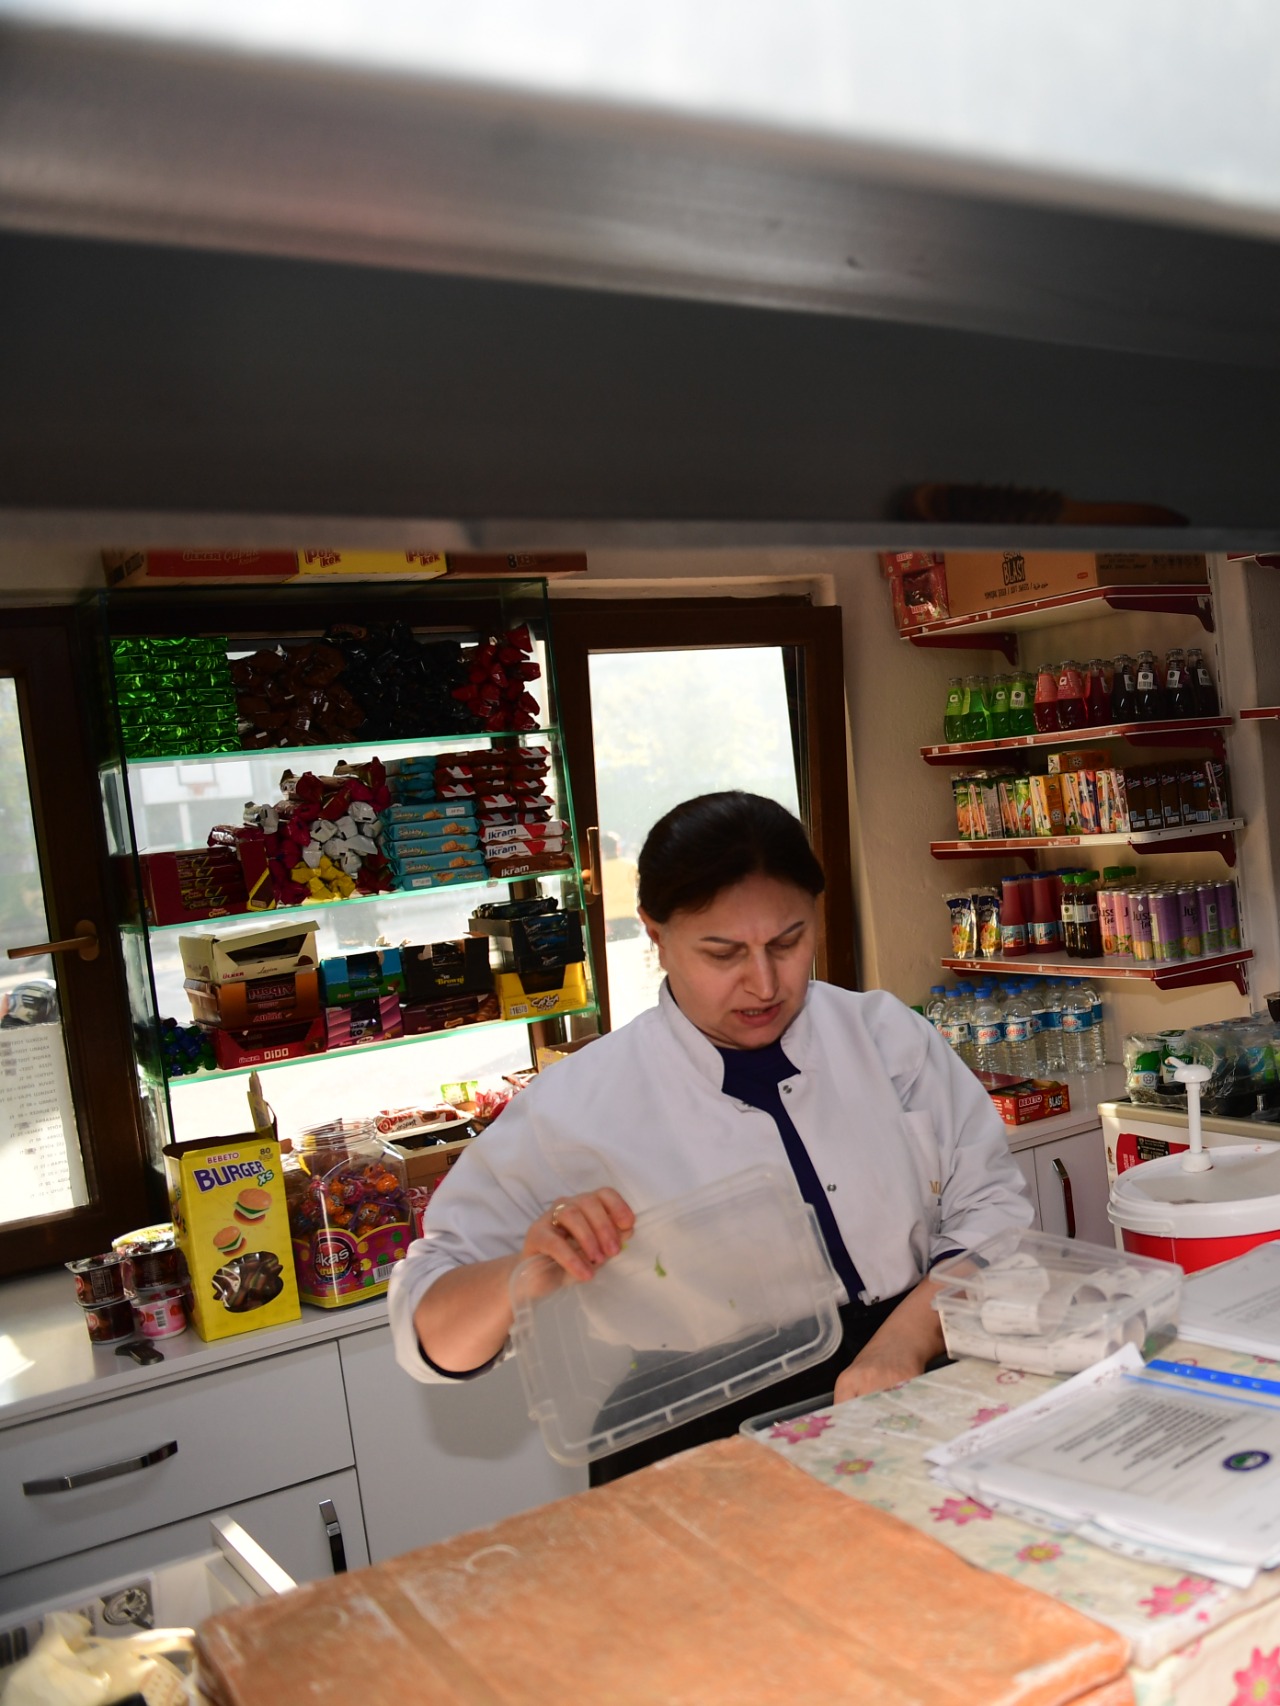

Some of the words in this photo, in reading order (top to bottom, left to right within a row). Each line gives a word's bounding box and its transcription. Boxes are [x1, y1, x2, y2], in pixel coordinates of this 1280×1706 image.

[1003, 559, 1025, 585] BLAST
[207, 1152, 240, 1164] BEBETO
[193, 1160, 266, 1193] BURGER
